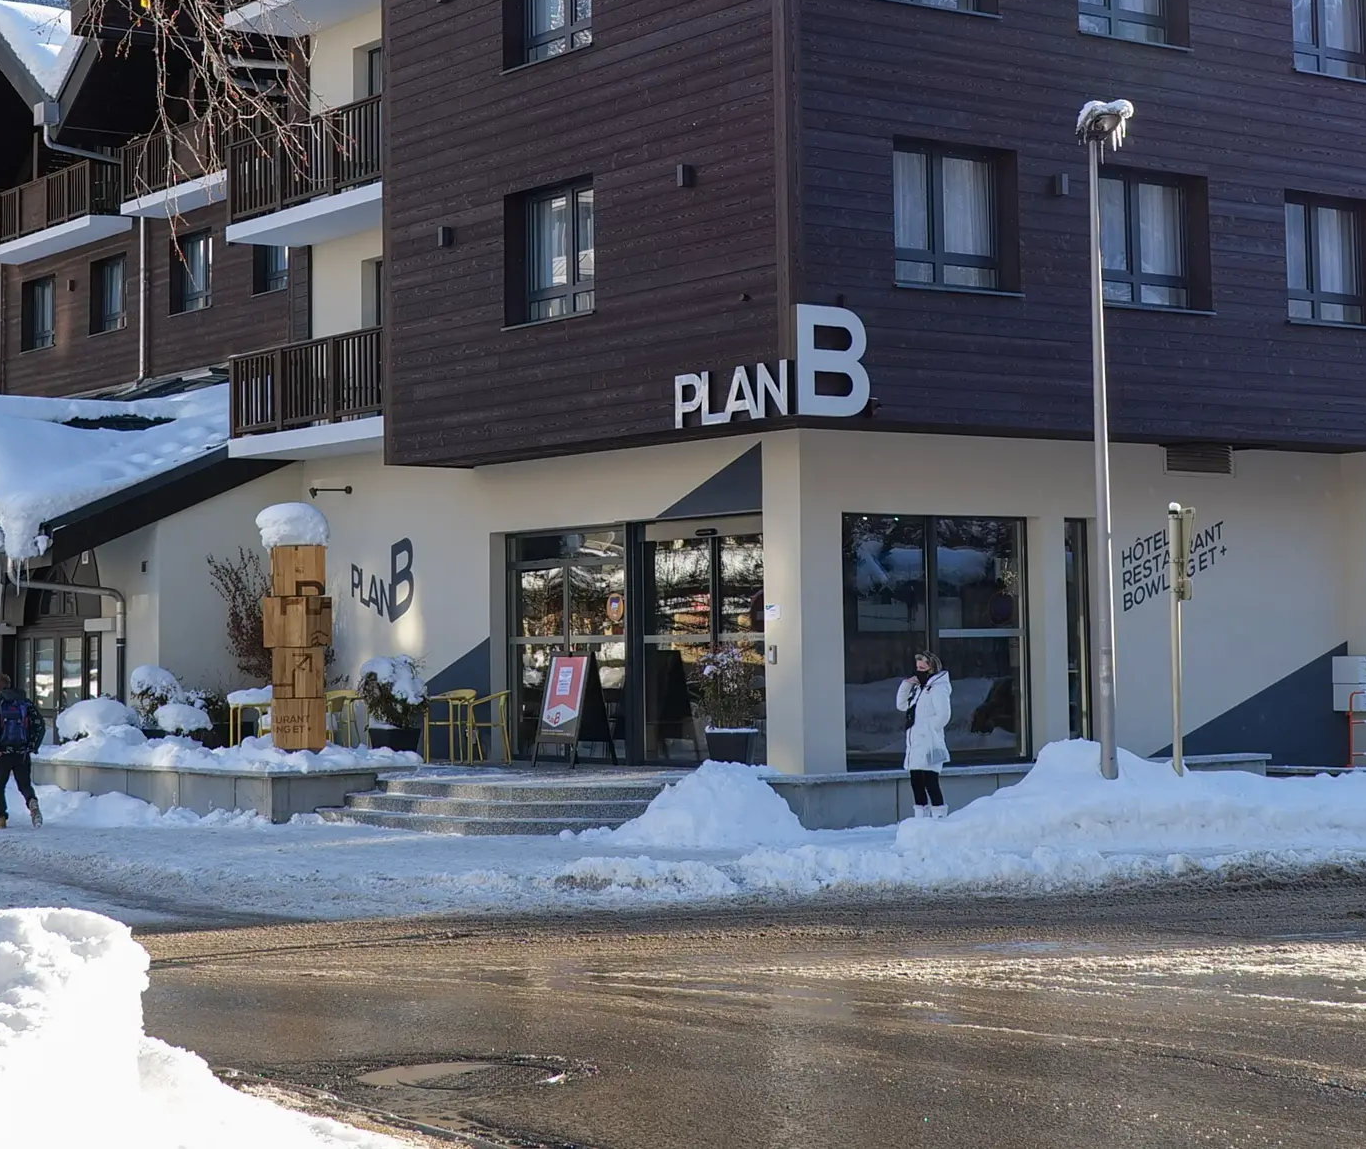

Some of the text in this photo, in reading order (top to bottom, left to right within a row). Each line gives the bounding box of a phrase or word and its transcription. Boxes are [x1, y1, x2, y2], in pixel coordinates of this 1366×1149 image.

[674, 303, 870, 429] PLAN B
[351, 563, 392, 622] PLAN
[391, 537, 414, 623] B
[1121, 529, 1170, 568] HÔTEL
[1122, 521, 1224, 590] RESTAANT
[1123, 558, 1196, 612] BOWLG
[1198, 546, 1217, 572] ET
[553, 711, 561, 725] B
